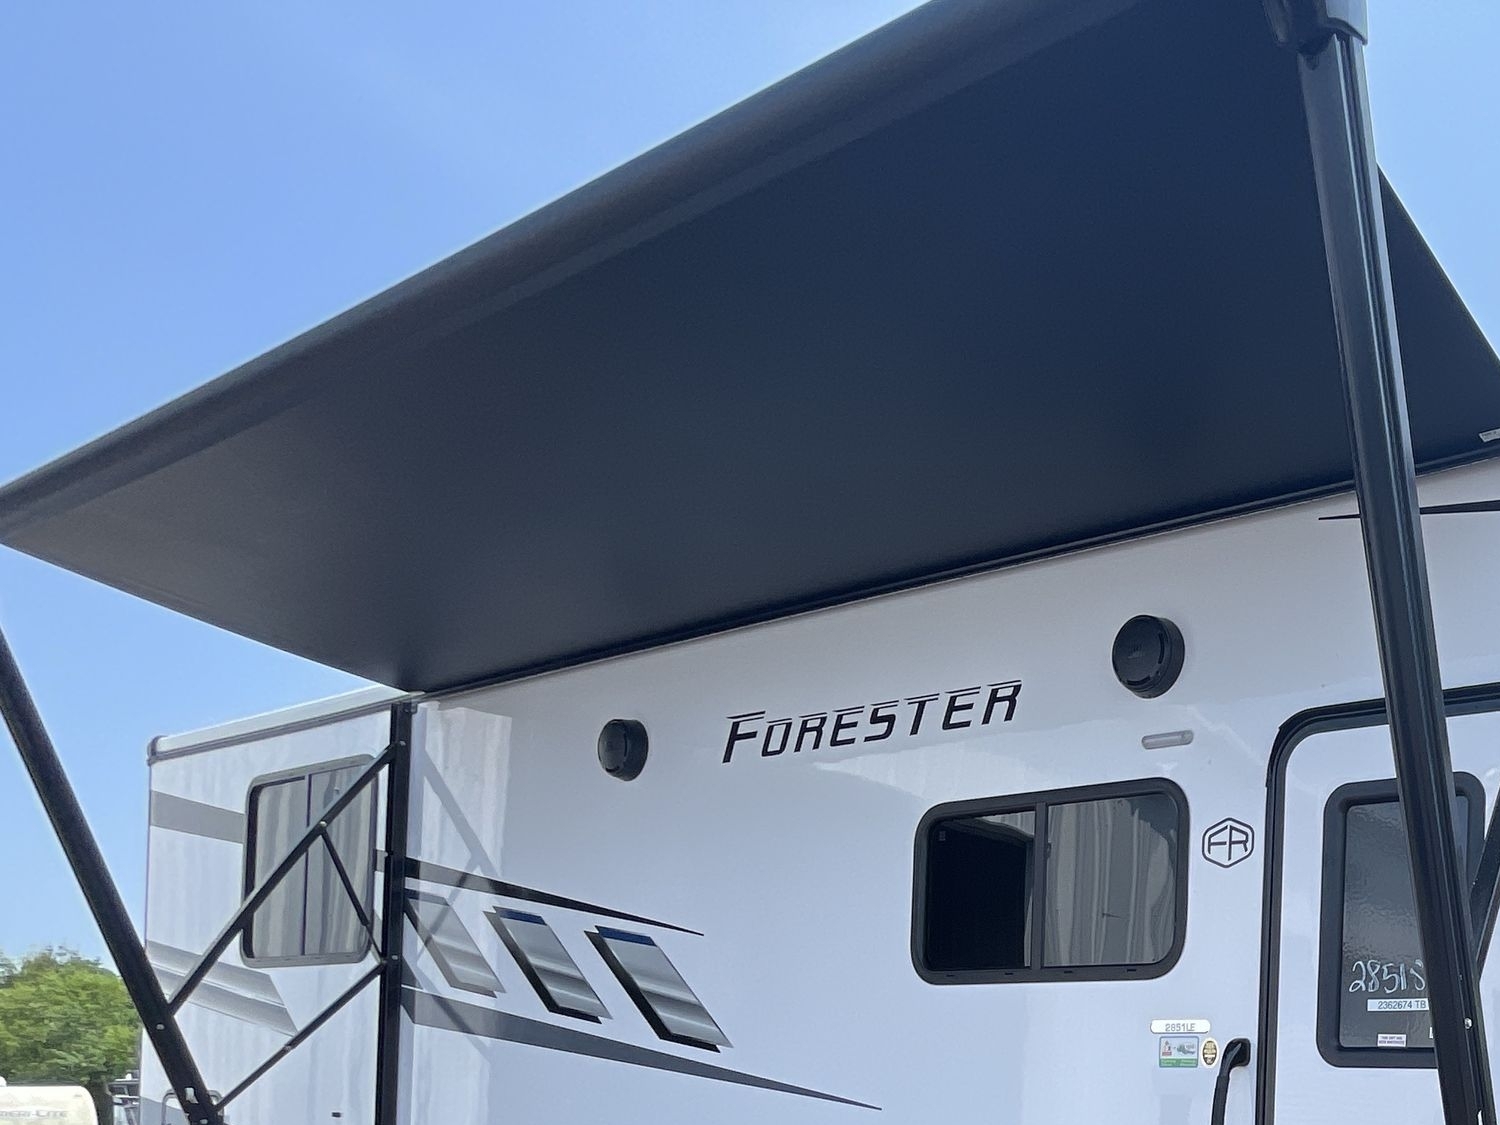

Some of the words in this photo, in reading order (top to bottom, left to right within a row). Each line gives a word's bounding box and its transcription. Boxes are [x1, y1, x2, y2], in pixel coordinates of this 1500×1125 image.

[722, 680, 1022, 763] FORESTER
[1378, 1001, 1412, 1009] 2362674
[1416, 1000, 1427, 1008] TB
[1165, 1023, 1196, 1031] 2851LE
